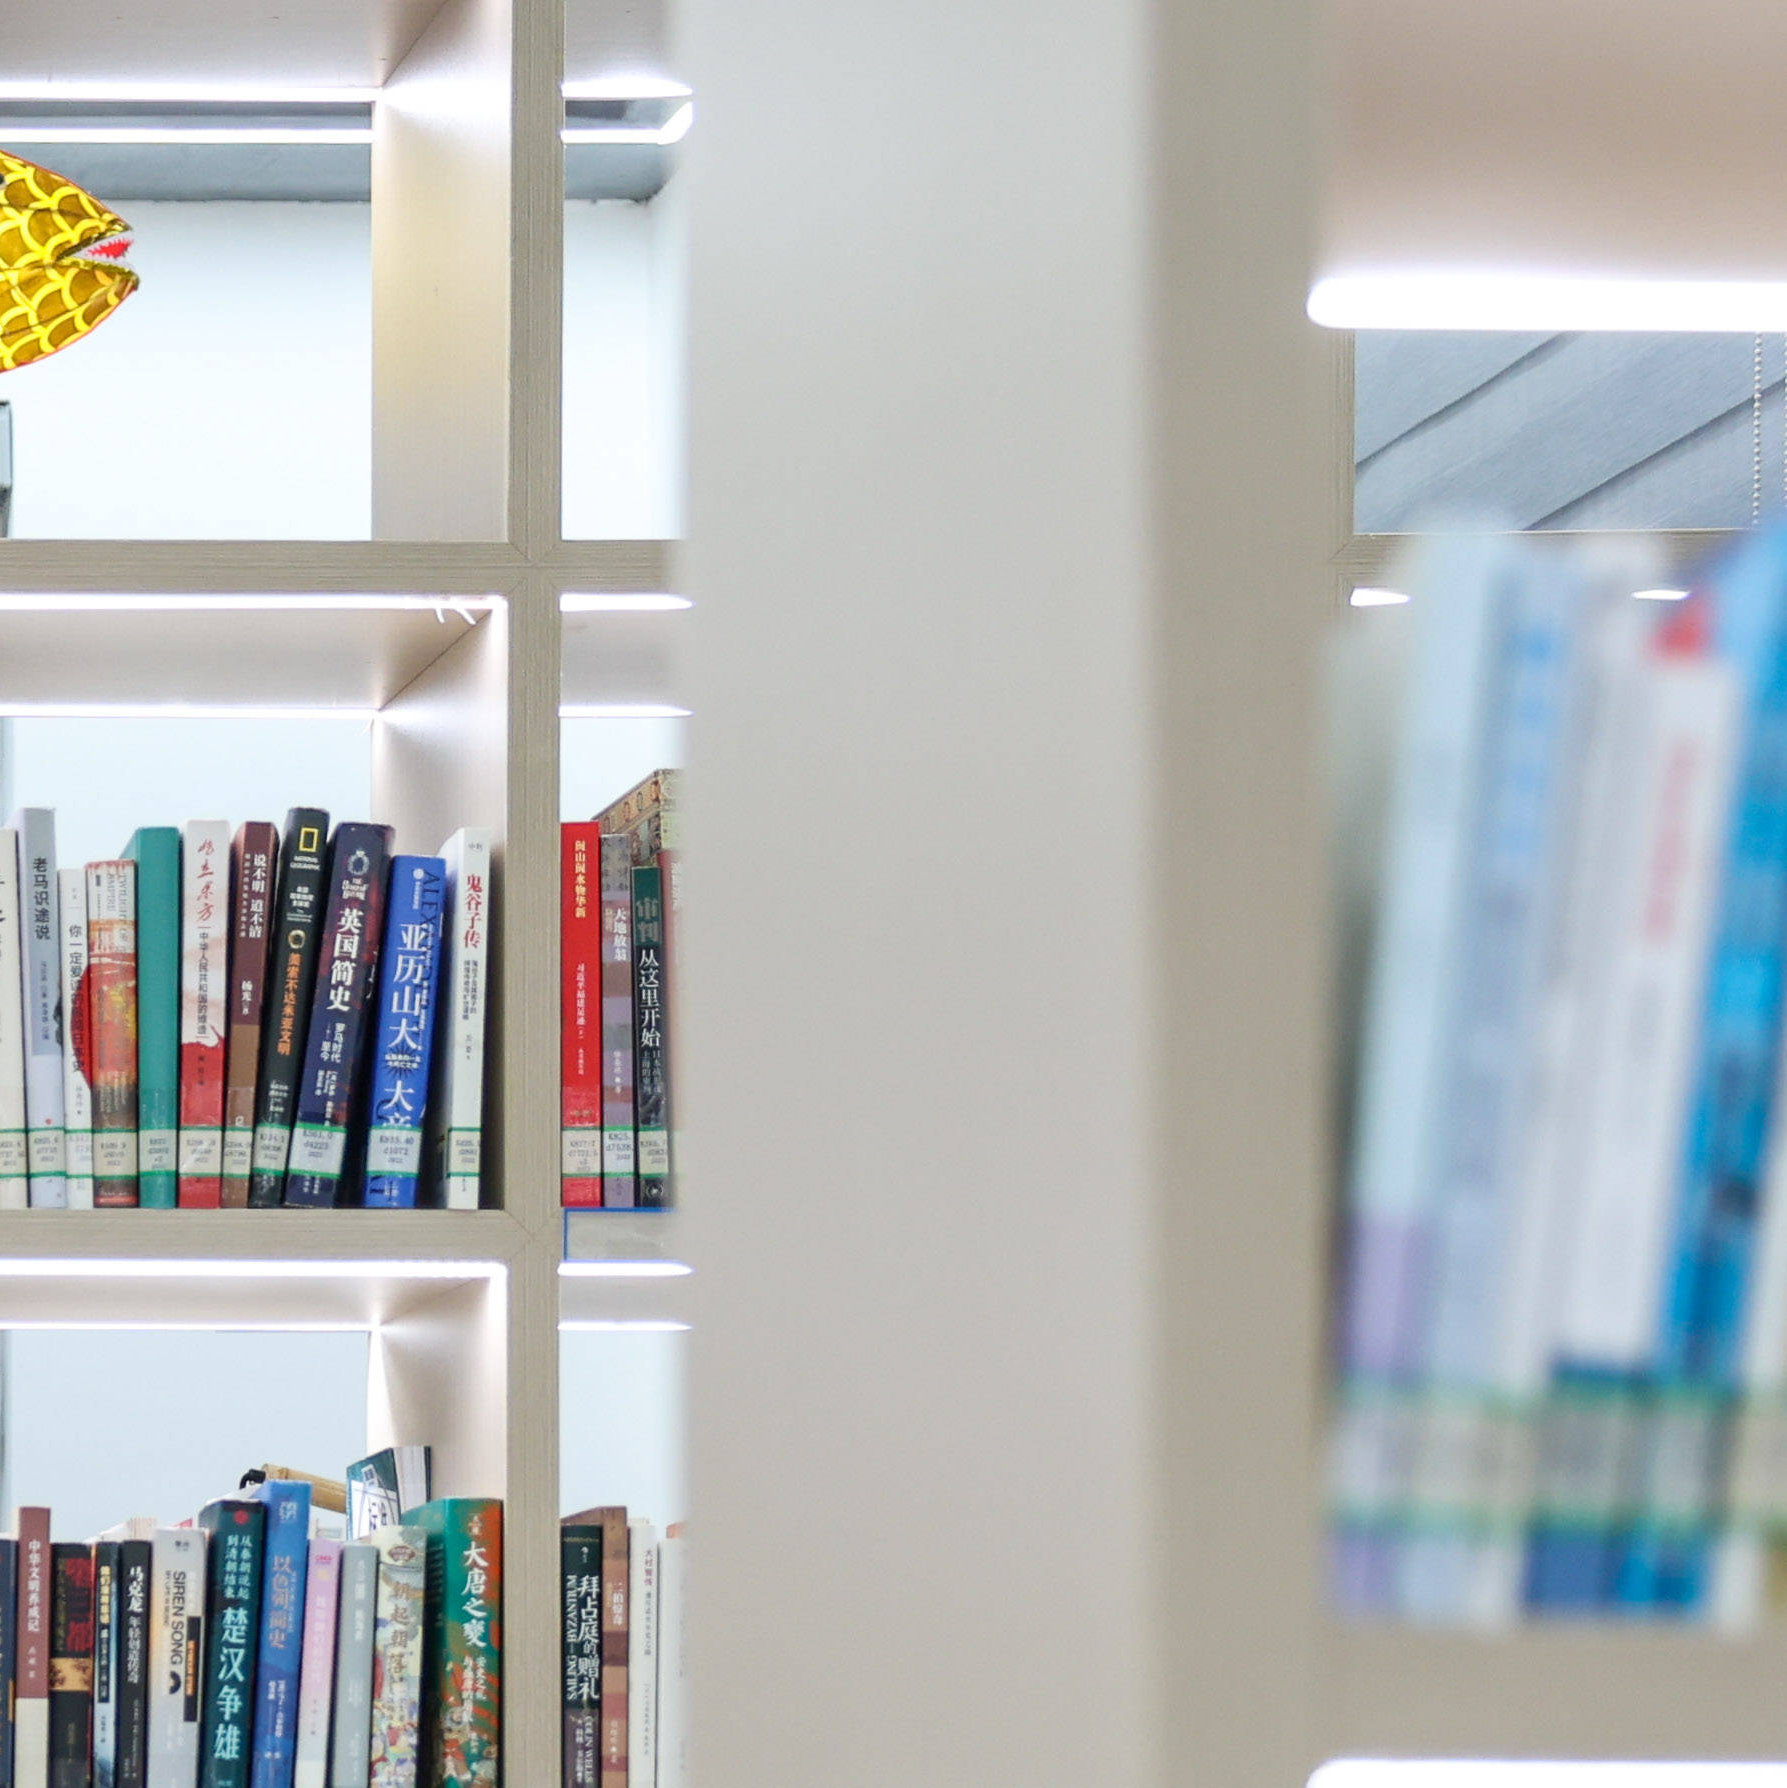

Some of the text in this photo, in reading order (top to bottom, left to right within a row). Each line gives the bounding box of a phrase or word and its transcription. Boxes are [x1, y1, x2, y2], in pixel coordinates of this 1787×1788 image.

[33, 857, 50, 940] 老马识途说
[248, 853, 267, 939] 说不明 道不清
[463, 874, 483, 949] 鬼谷子传
[574, 839, 587, 919] 闽山闽水物华新
[326, 907, 364, 1012] 英国简史
[638, 949, 661, 1048] 从这里开始
[170, 1571, 187, 1665] SIREN SONG
[566, 1574, 578, 1642] BYZANTIUM
[577, 1574, 600, 1700] 拜占庭的赠礼
[213, 1606, 249, 1760] 楚汉争雄
[566, 1655, 578, 1700] SAILING
